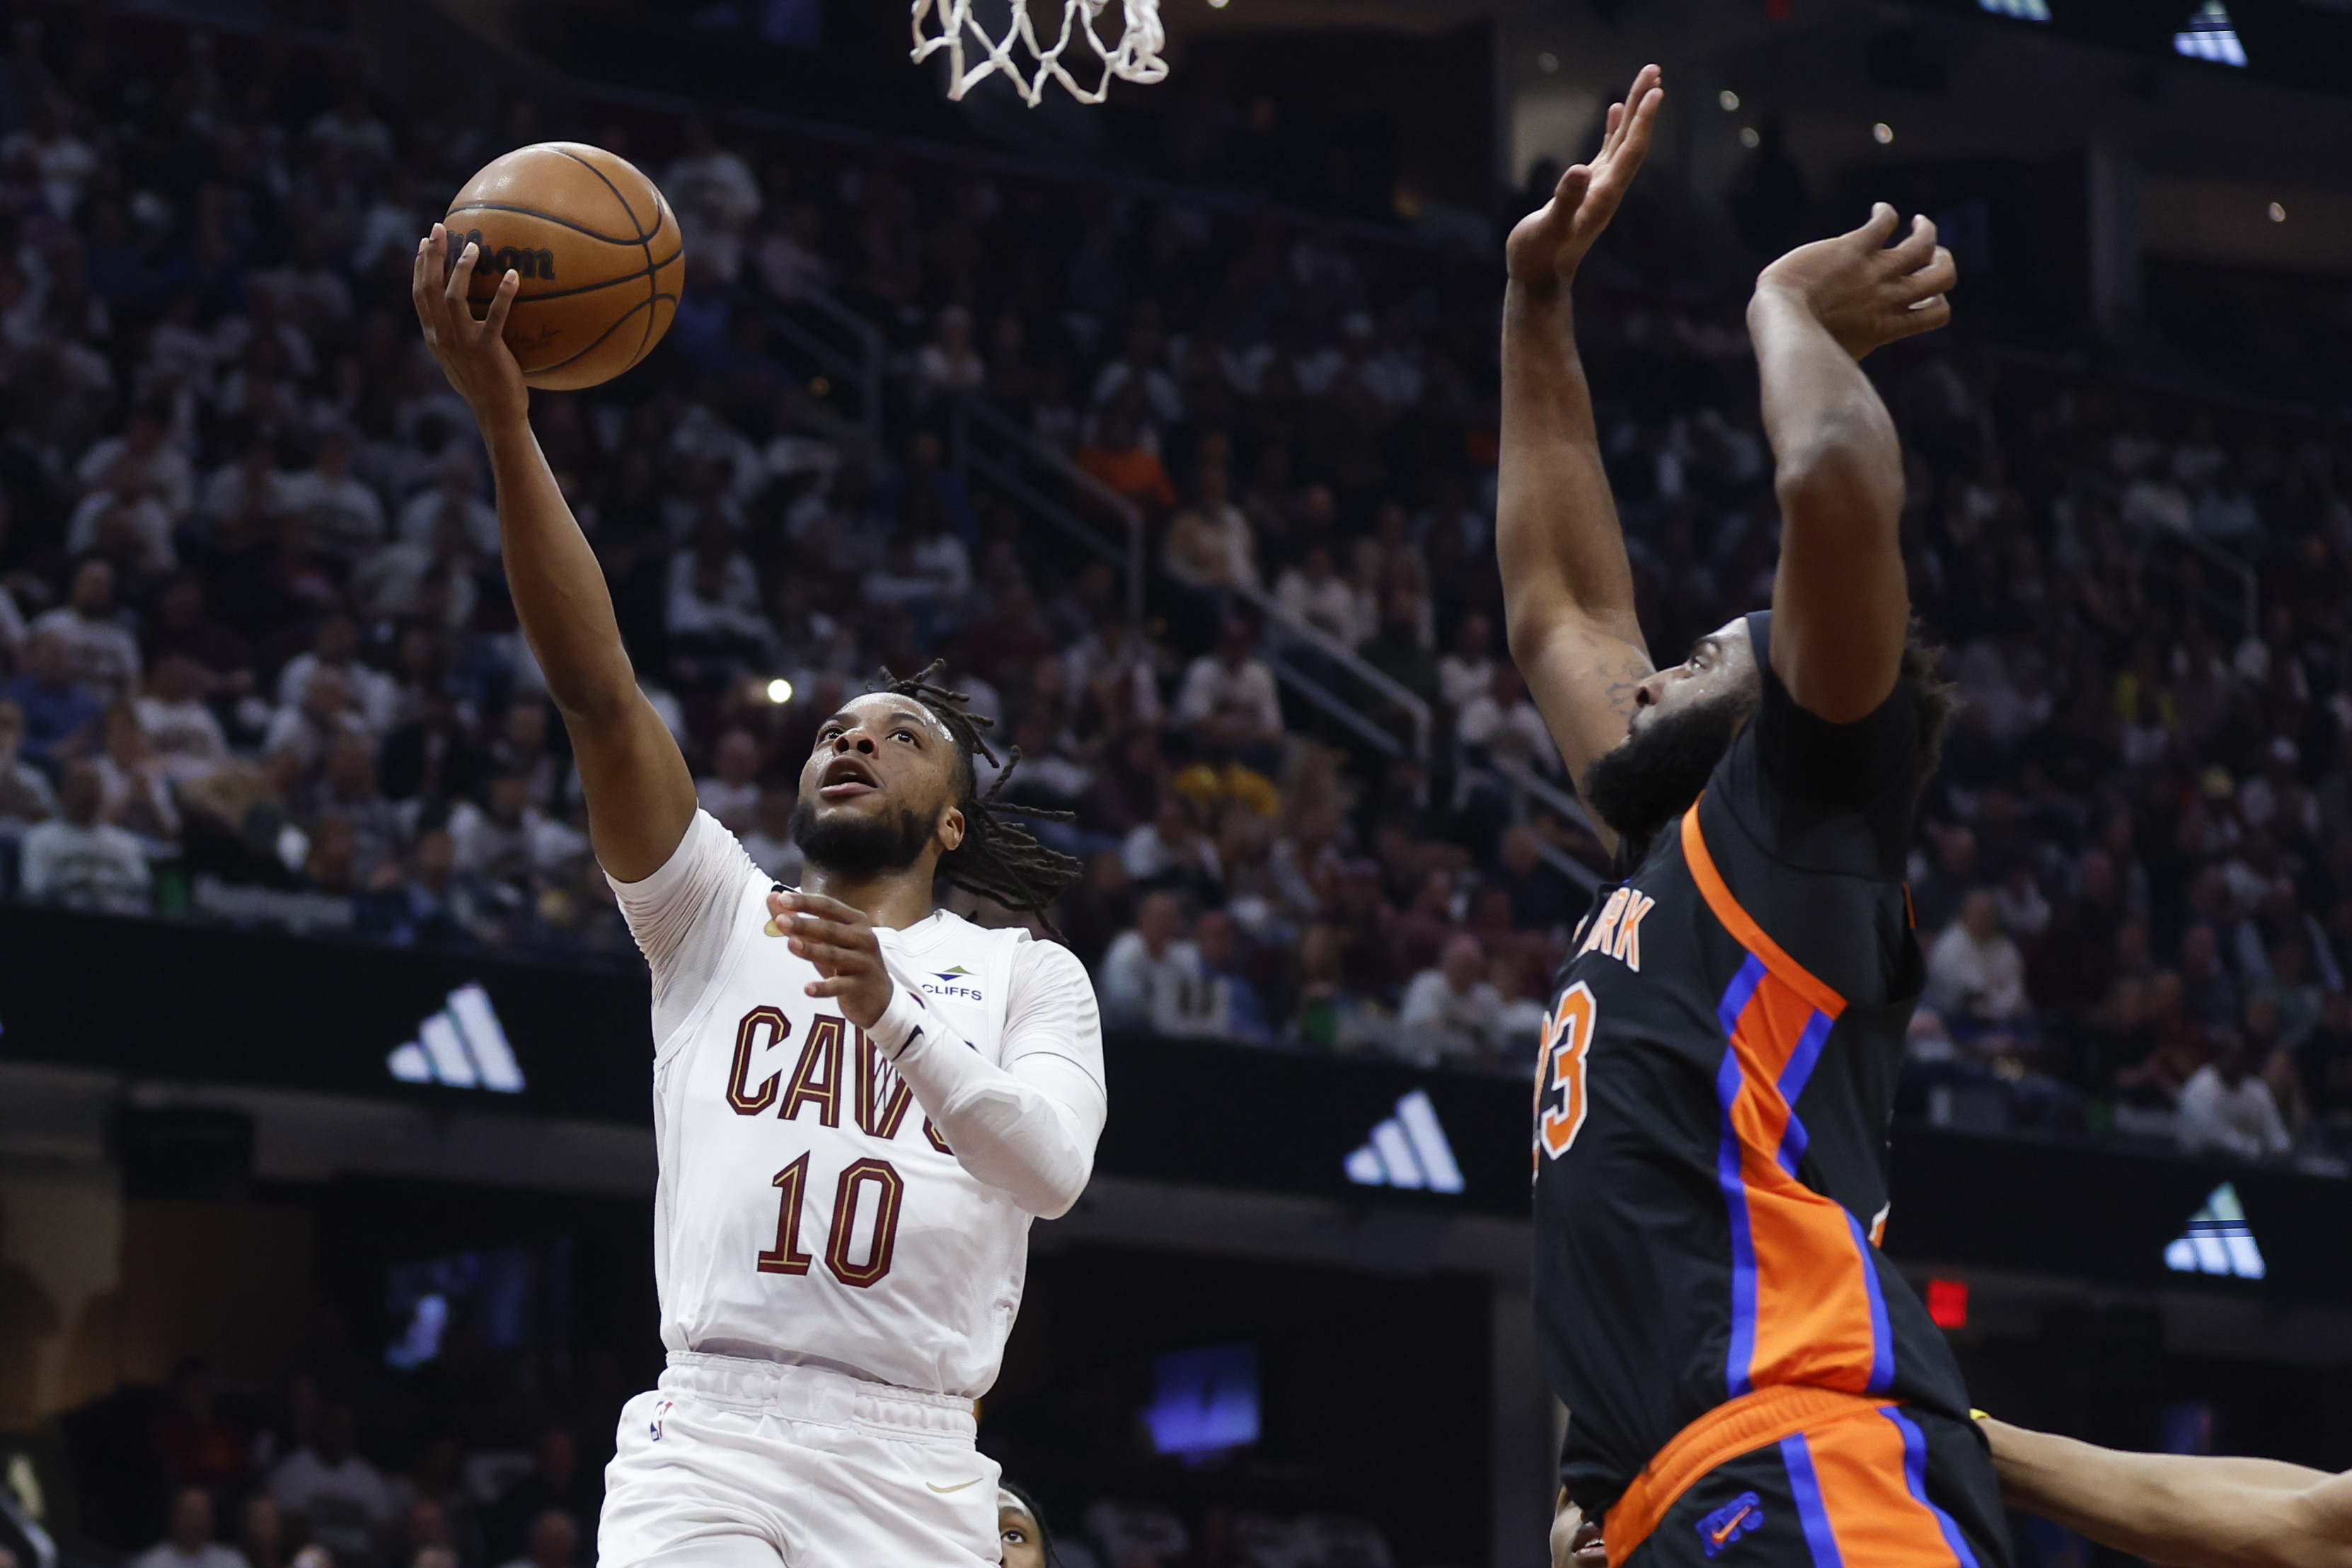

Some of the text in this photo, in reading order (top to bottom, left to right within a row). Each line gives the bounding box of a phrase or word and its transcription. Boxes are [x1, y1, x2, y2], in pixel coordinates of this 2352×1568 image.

[922, 984, 982, 1001] CLIFFS
[727, 1005, 955, 1155] CAV
[1531, 979, 1597, 1186] 3
[757, 1150, 904, 1288] 10
